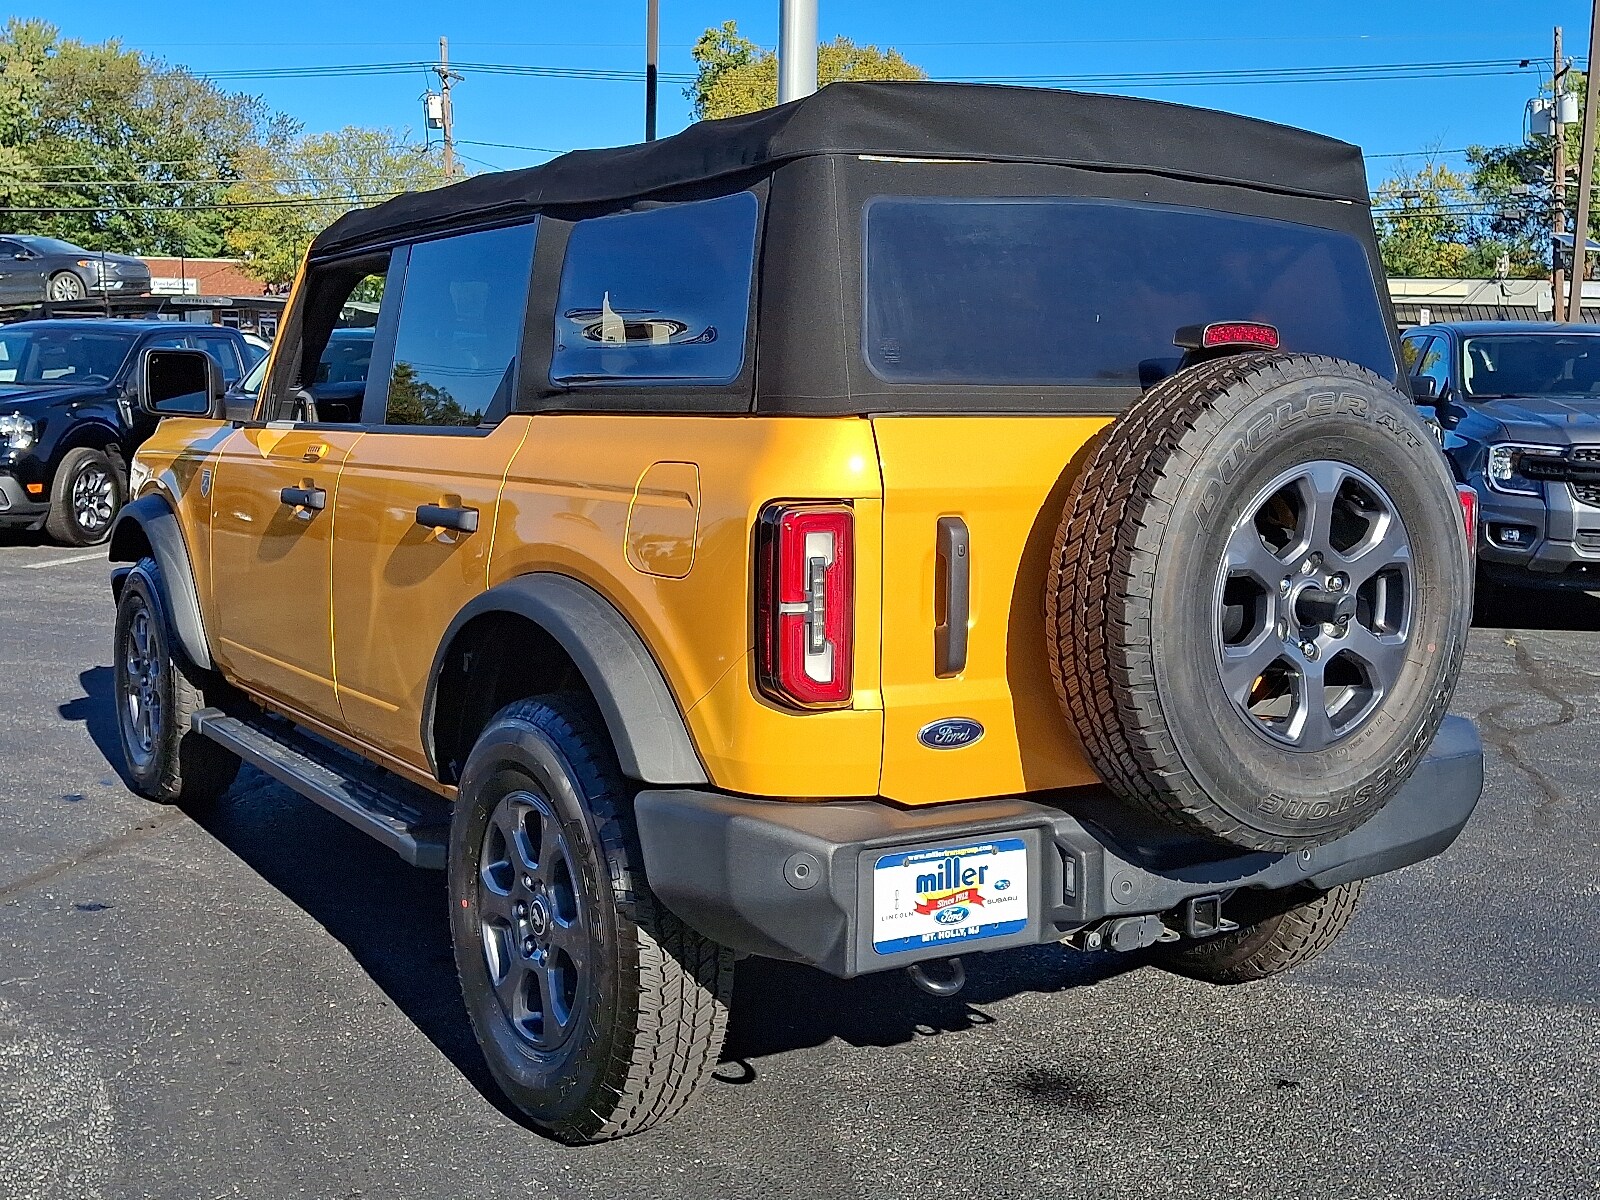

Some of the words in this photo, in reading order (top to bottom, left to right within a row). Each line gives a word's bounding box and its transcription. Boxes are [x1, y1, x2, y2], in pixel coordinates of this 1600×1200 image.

[1194, 391, 1369, 530] DUELER
[1375, 410, 1425, 449] A/T
[934, 725, 971, 743] Ford
[916, 857, 989, 893] miller
[937, 897, 955, 908] Since
[987, 895, 1018, 905] SUBARU
[881, 911, 914, 922] LINCOLN
[940, 907, 965, 923] Ford
[921, 931, 937, 942] MT.
[937, 928, 967, 938] HOLLY,
[967, 925, 980, 935] NJ
